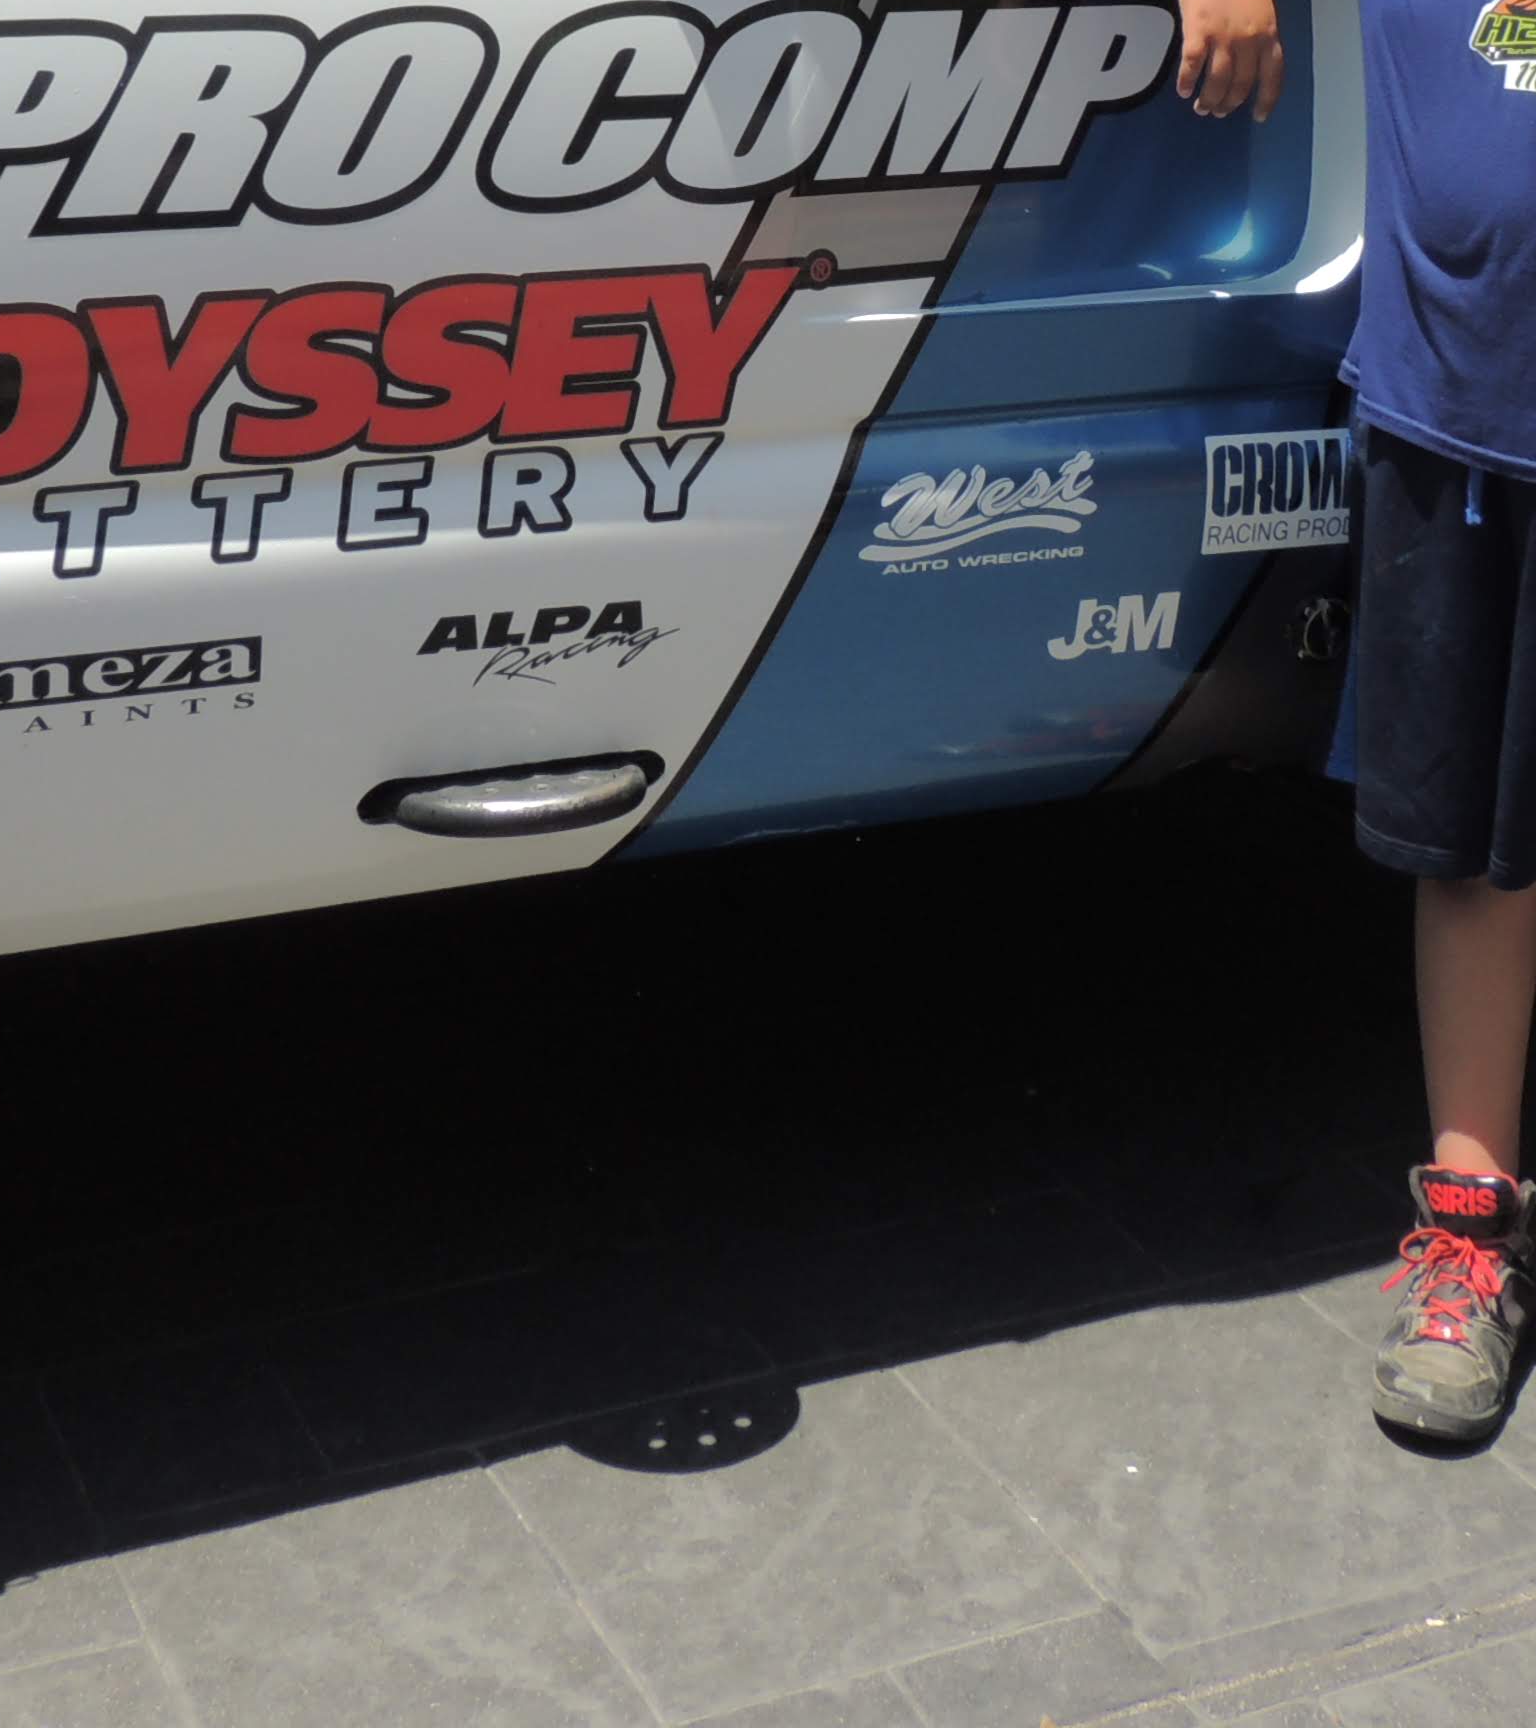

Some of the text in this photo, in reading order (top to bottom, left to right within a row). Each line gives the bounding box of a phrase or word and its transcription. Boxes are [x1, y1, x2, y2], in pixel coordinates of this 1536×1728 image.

[880, 450, 1096, 539] West
[881, 544, 1086, 576] AUTO WRECKING
[1206, 520, 1290, 547] RACING
[417, 599, 645, 656] ALPA
[1047, 591, 1181, 661] J&M
[472, 626, 682, 688] Racing
